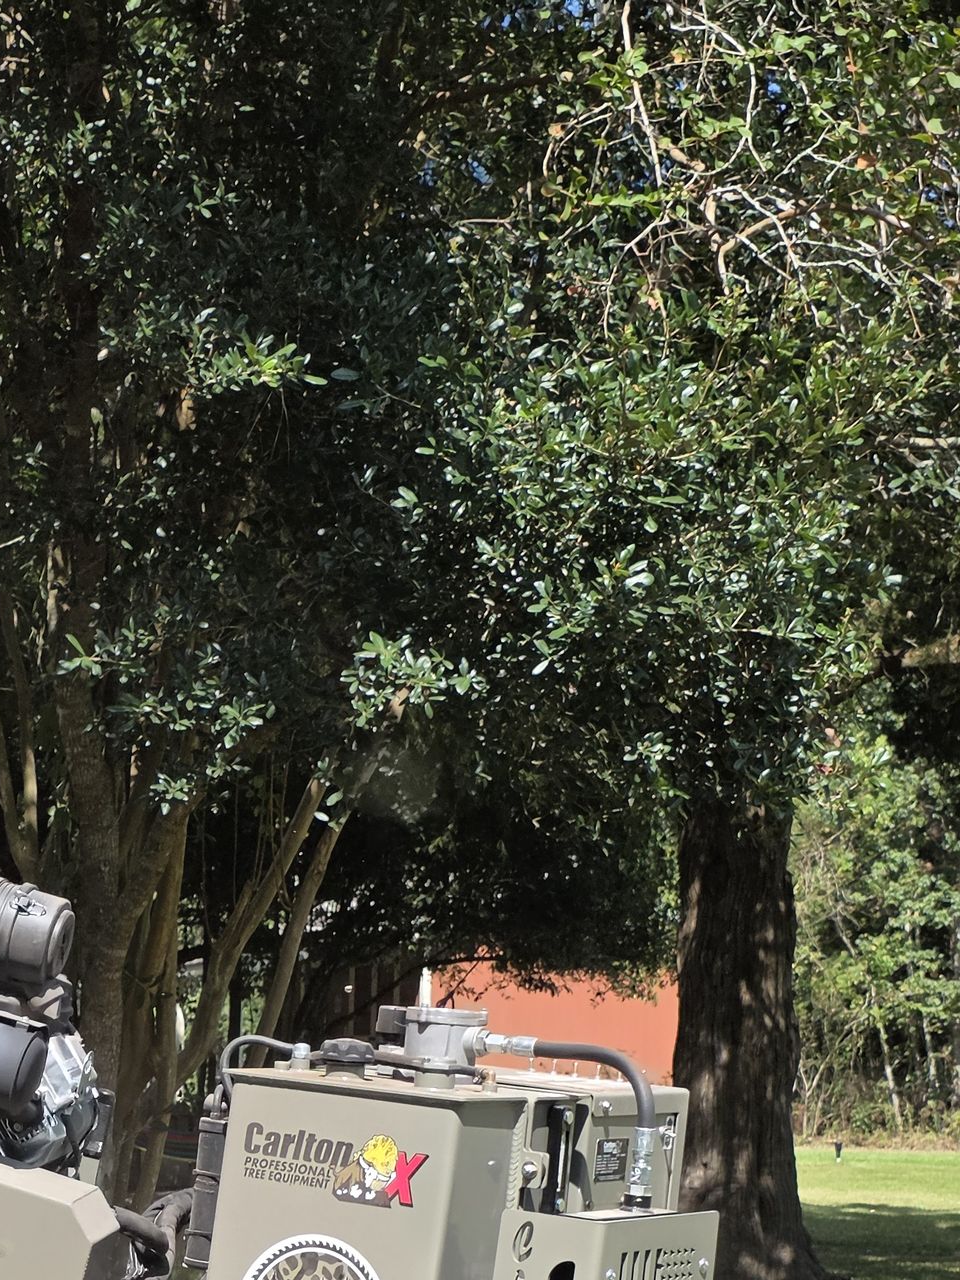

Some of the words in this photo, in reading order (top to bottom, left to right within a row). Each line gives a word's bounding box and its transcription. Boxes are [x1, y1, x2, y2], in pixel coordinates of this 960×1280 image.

[244, 1122, 354, 1168] Carlton
[243, 1167, 266, 1181] TREE
[268, 1172, 330, 1190] EQUIPMENT
[244, 1156, 333, 1179] PROFESSIONAL
